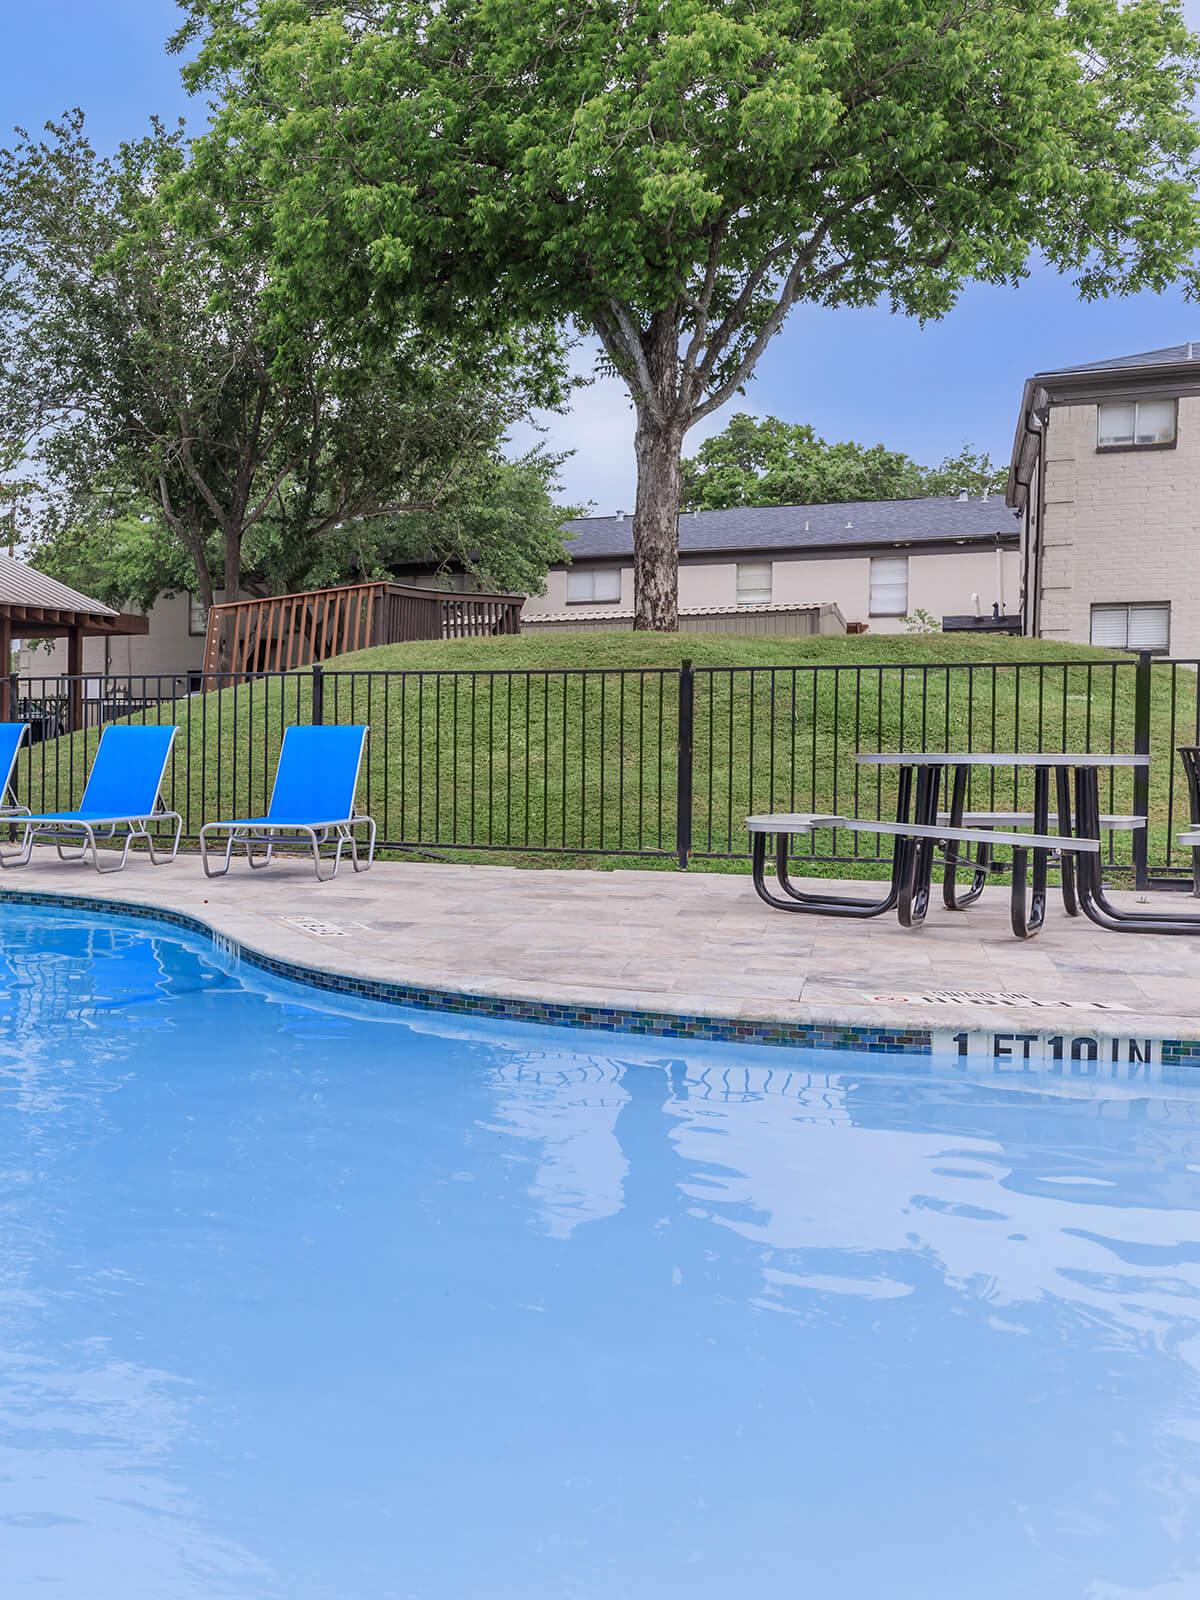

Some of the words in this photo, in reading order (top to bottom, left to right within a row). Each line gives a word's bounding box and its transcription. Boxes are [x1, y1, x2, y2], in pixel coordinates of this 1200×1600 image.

[952, 1033, 968, 1056] 1
[993, 1034, 1039, 1059] FT
[1047, 1036, 1098, 1060] 10
[1111, 1038, 1151, 1063] IN
